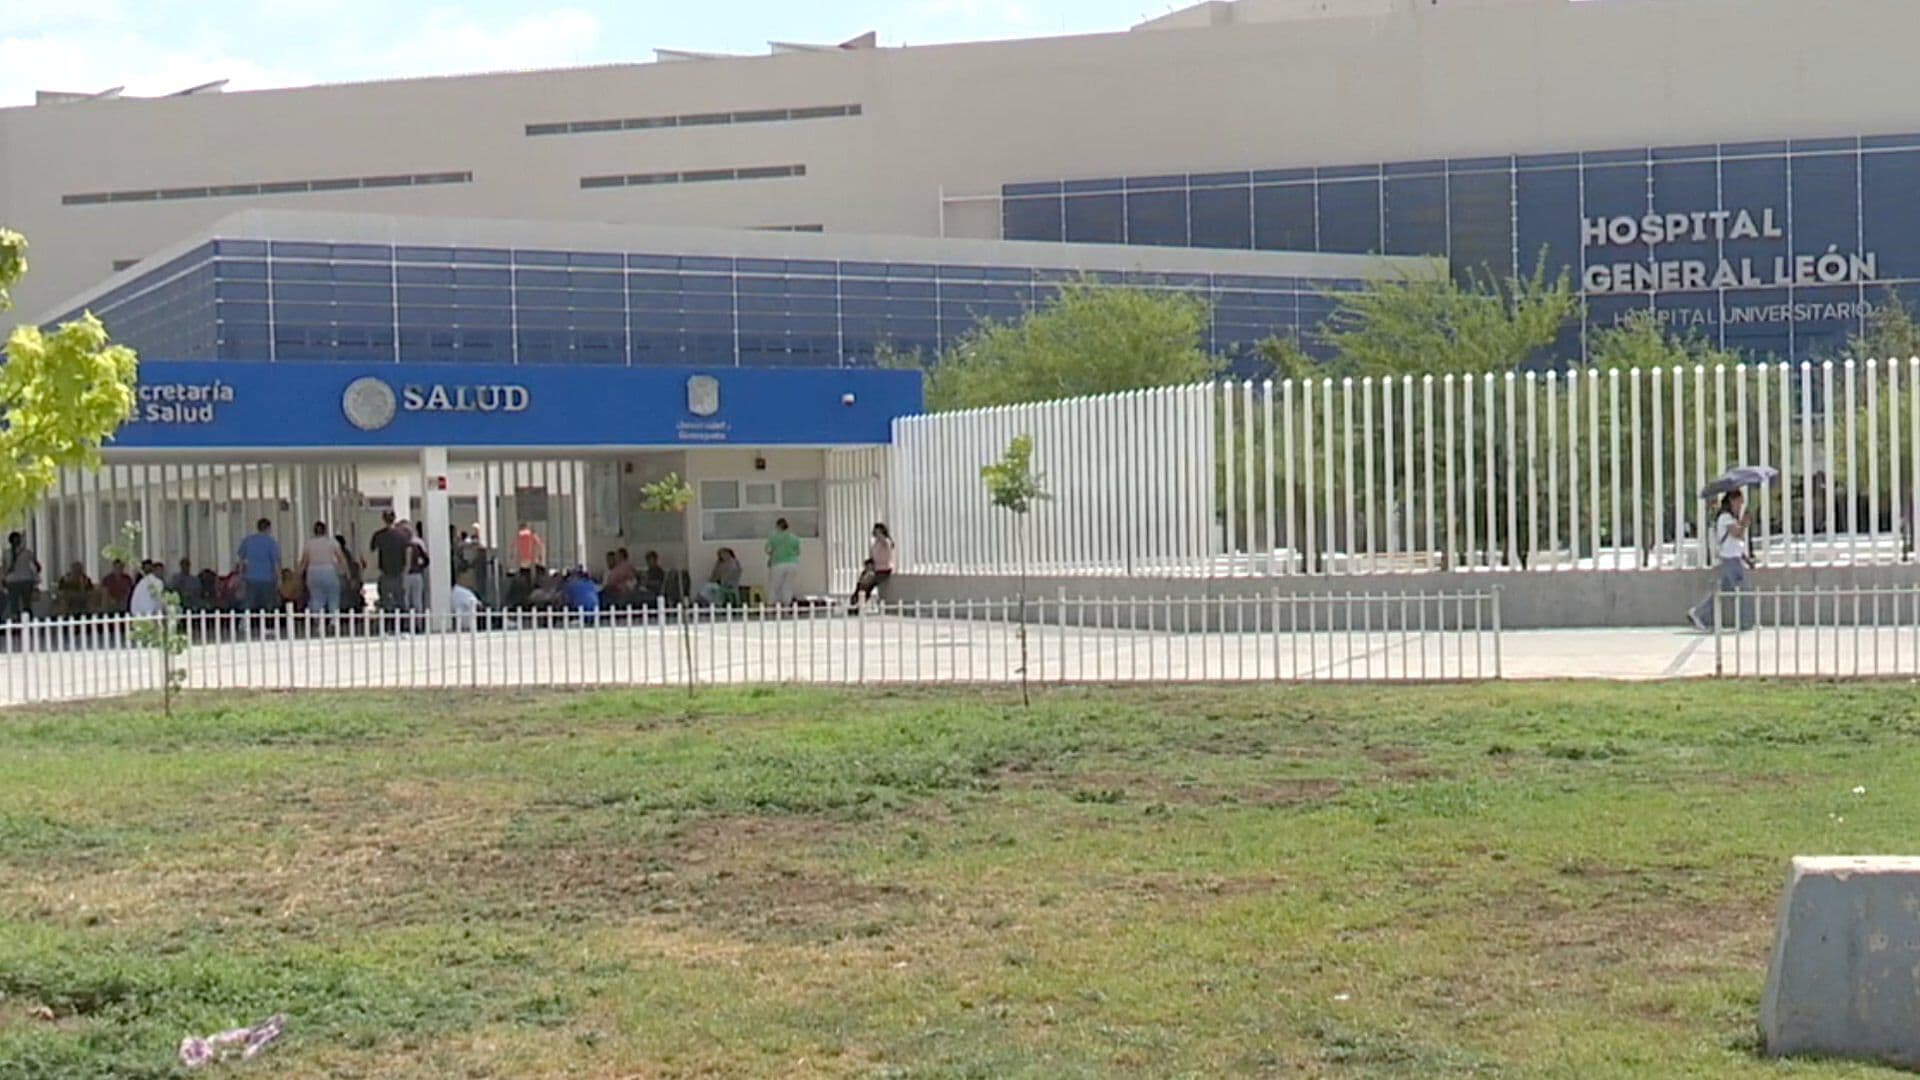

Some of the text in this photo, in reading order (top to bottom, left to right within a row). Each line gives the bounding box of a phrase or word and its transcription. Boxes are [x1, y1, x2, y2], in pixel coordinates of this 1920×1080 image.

[1582, 208, 1782, 246] HOSPITAL
[1584, 244, 1876, 293] GENERAL LEÓN
[1614, 301, 1873, 328] HPITAL UNIVERSITARIO
[140, 380, 234, 401] cretaría
[403, 384, 529, 411] SALUD
[146, 403, 213, 422] Salud
